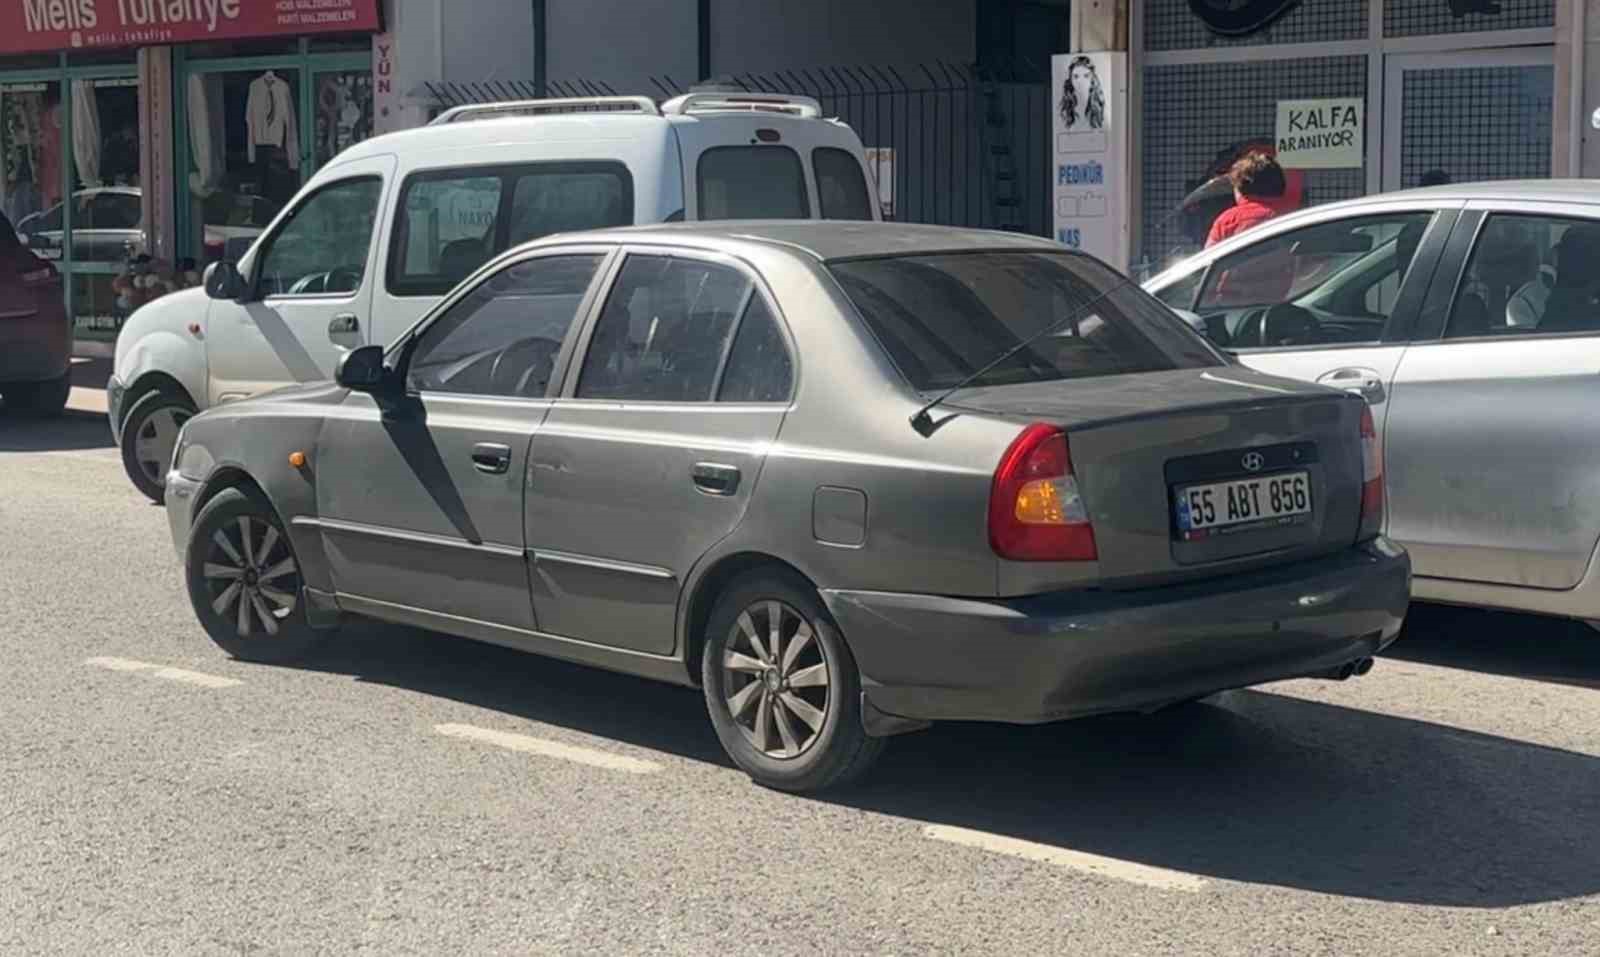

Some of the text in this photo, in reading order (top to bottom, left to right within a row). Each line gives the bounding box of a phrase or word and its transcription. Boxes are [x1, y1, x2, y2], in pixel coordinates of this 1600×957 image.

[377, 44, 391, 93] YÜN
[1288, 105, 1358, 132] KALFA
[1278, 129, 1354, 153] ARANIYOR
[1190, 489, 1216, 525] 55
[1226, 482, 1260, 521] ABT
[1269, 477, 1307, 514] 856
